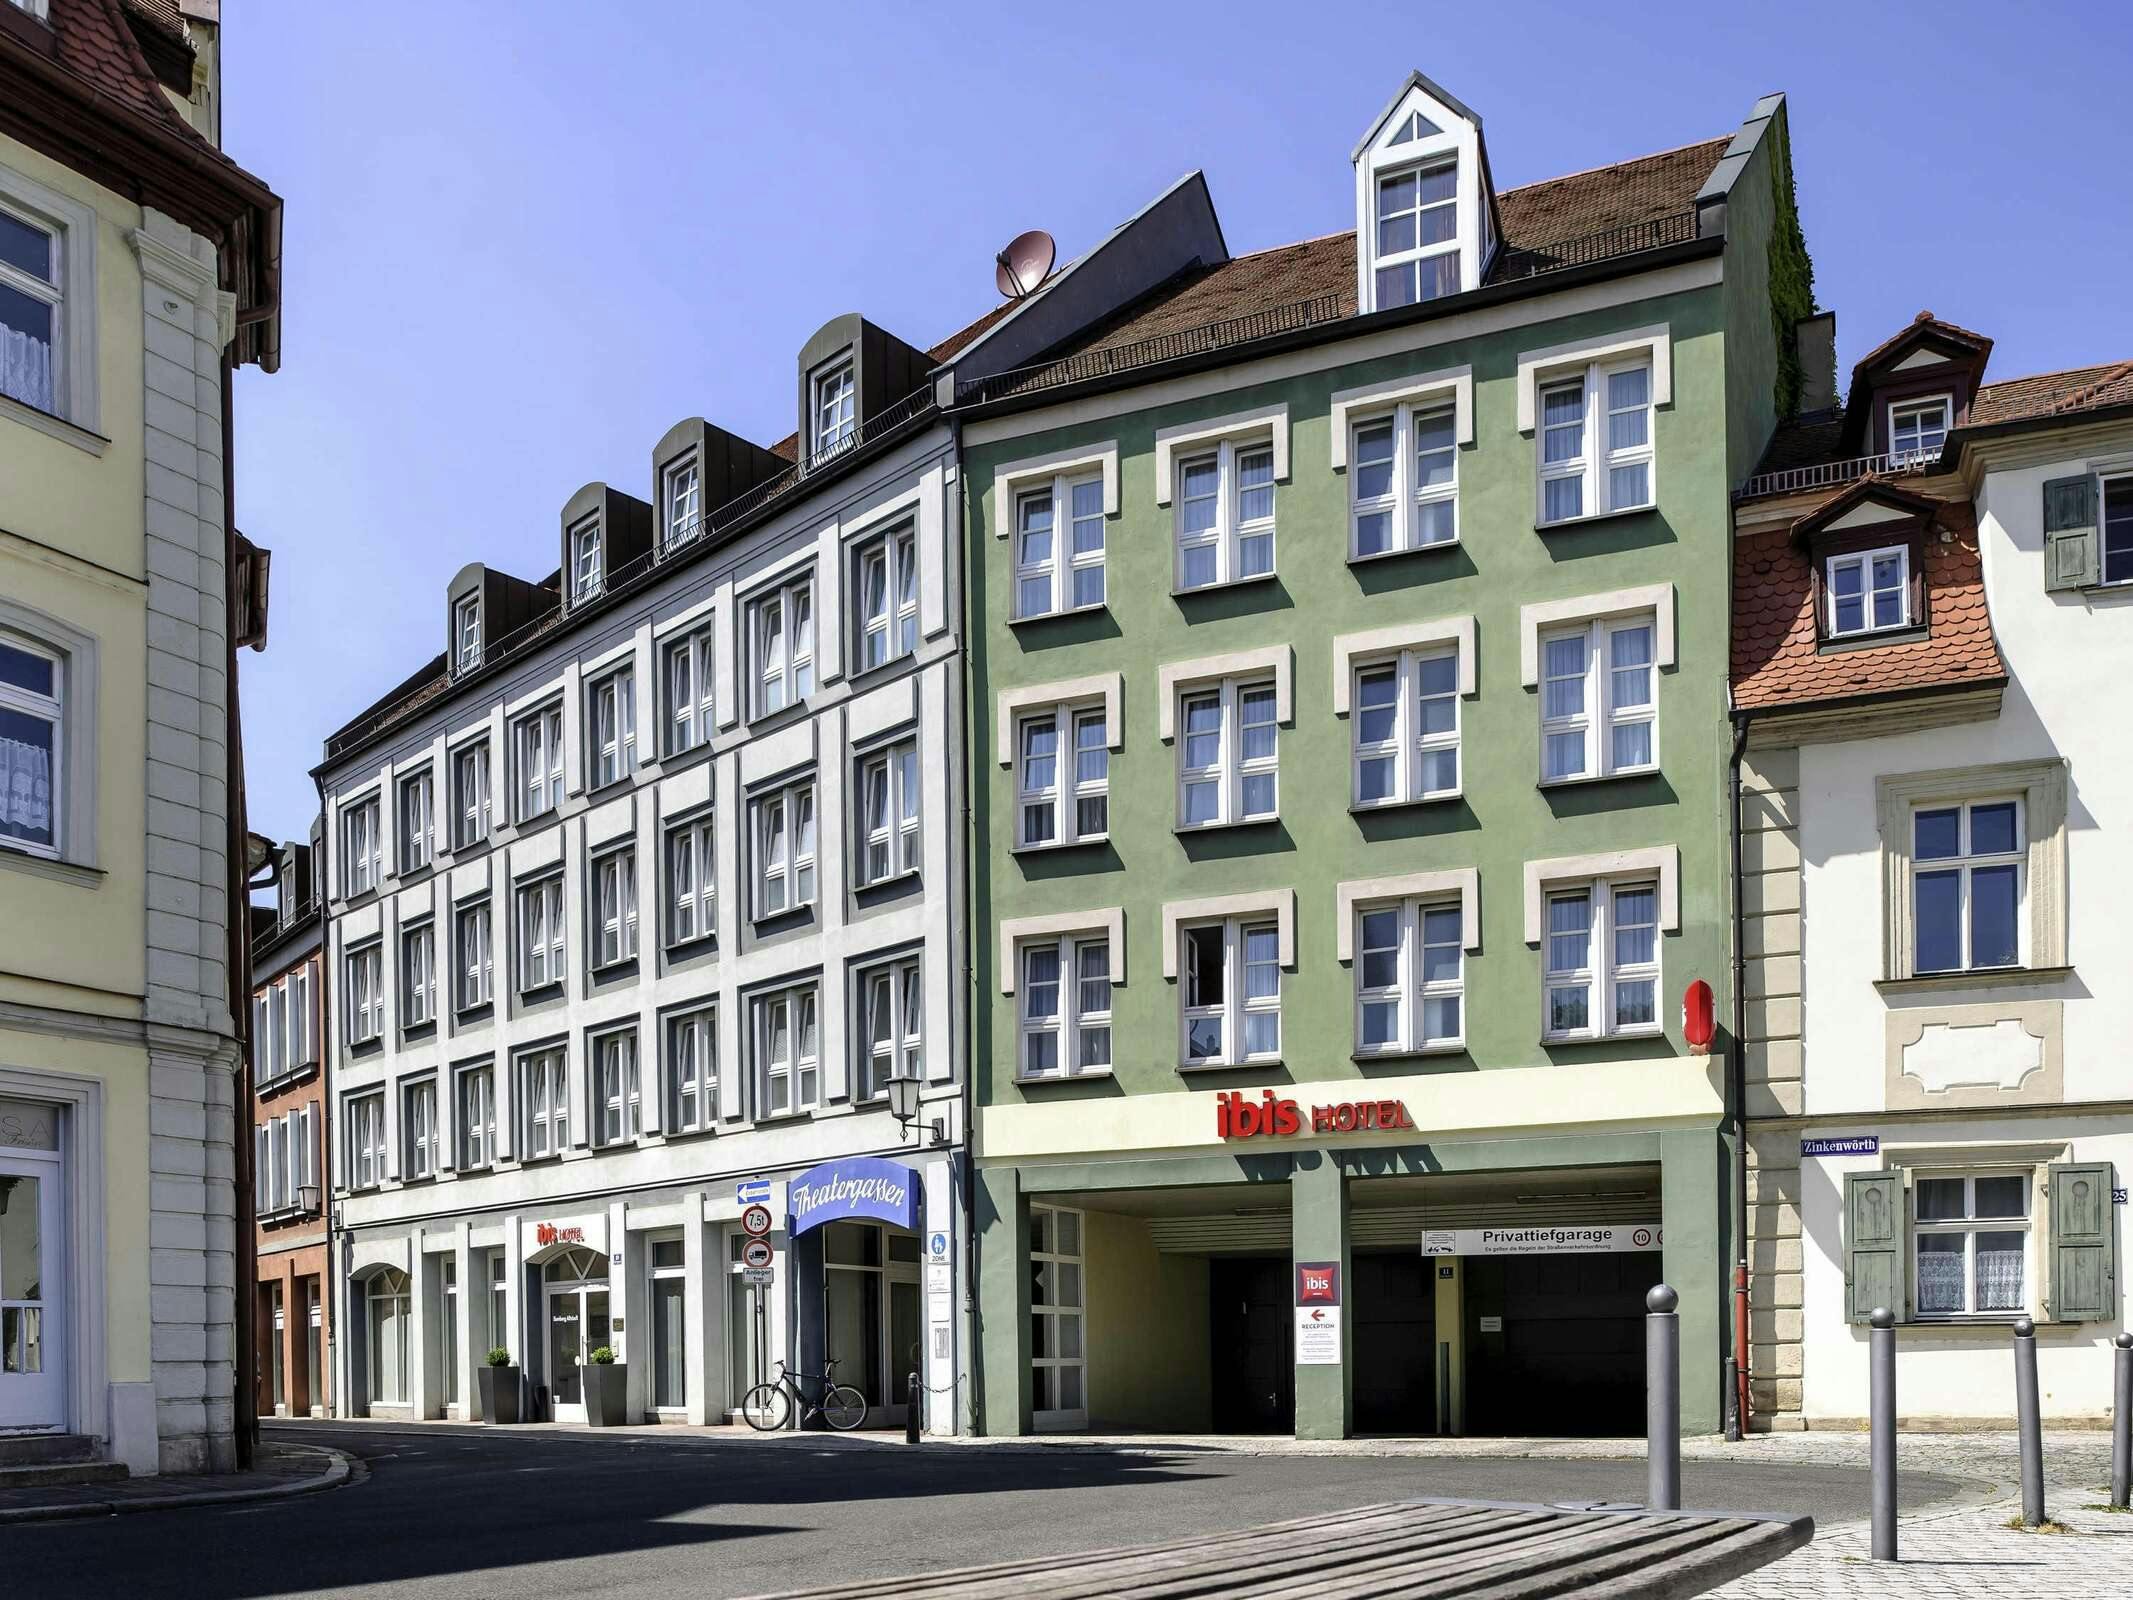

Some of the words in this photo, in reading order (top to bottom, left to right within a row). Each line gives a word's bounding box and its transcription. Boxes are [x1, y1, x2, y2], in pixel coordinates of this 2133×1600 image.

[1217, 1090, 1300, 1138] ibis
[1311, 1100, 1413, 1132] HOTEL
[1804, 1139, 1875, 1153] Zinkenwörth
[792, 1172, 906, 1220] Theatergassen
[2112, 1190, 2127, 1202] 25
[749, 1213, 765, 1228] 7,5t
[536, 1223, 558, 1244] ibis
[559, 1227, 584, 1241] HOTEL
[1483, 1229, 1613, 1243] Privattiefgarage
[1637, 1233, 1647, 1242] 10
[1306, 1277, 1328, 1289] ibis
